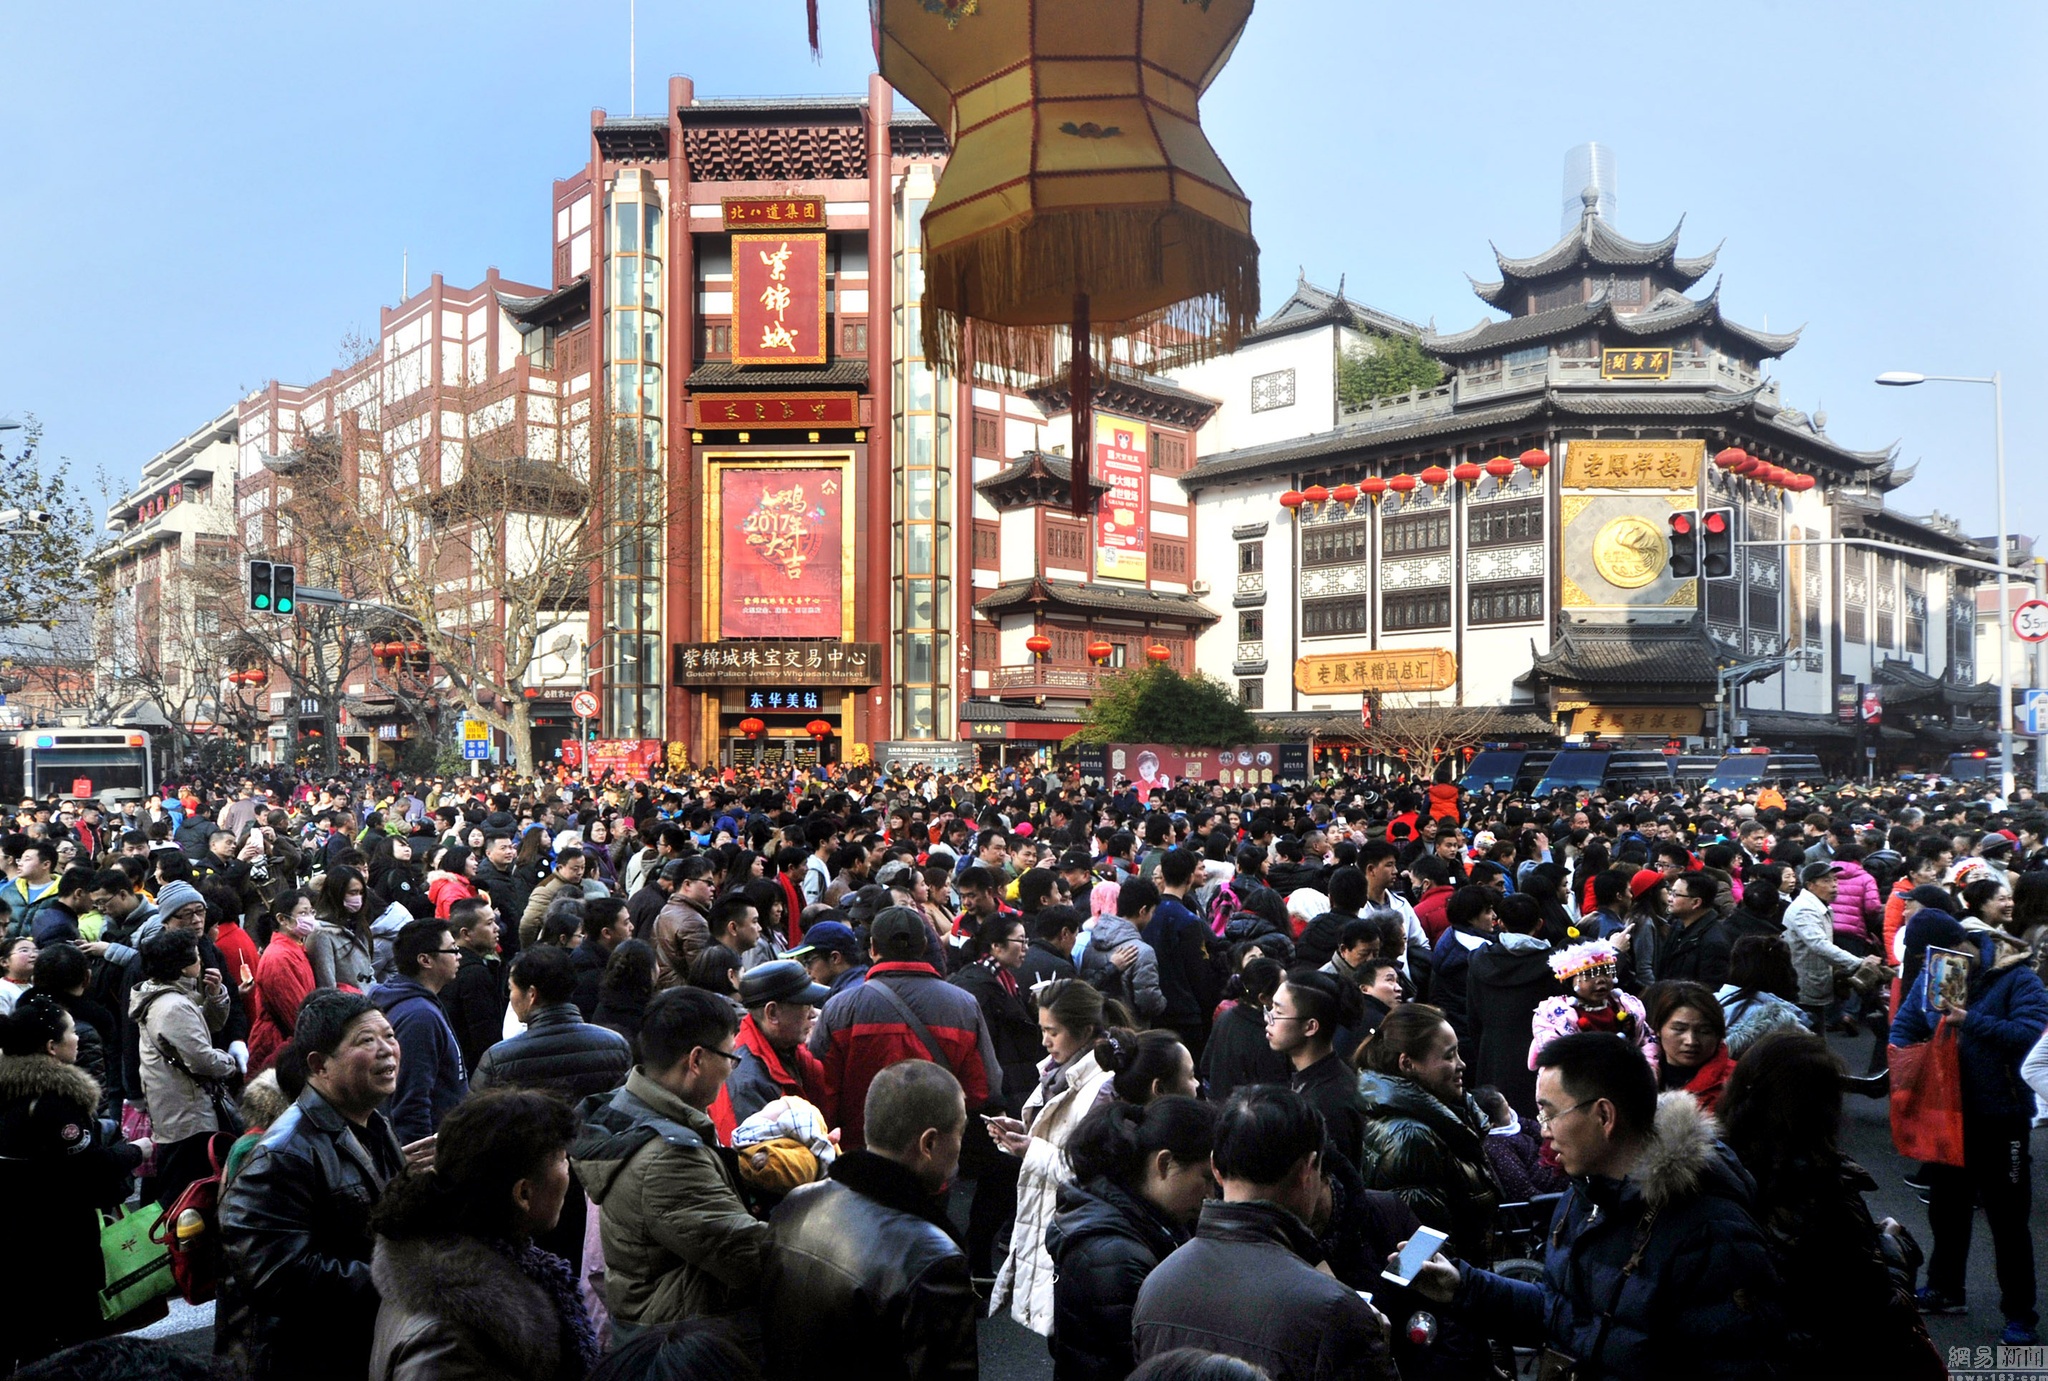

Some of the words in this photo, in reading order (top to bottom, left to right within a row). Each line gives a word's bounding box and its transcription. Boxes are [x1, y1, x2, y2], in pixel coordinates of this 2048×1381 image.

[731, 203, 815, 220] 北八道集团
[682, 647, 867, 669] 紫锦城珠宝交易中心
[685, 670, 716, 678] Golden
[717, 670, 747, 678] Palace
[782, 670, 830, 678] Wholesale
[832, 670, 864, 678] Market
[750, 692, 818, 709] 东华美钻
[467, 741, 485, 749] 车辆
